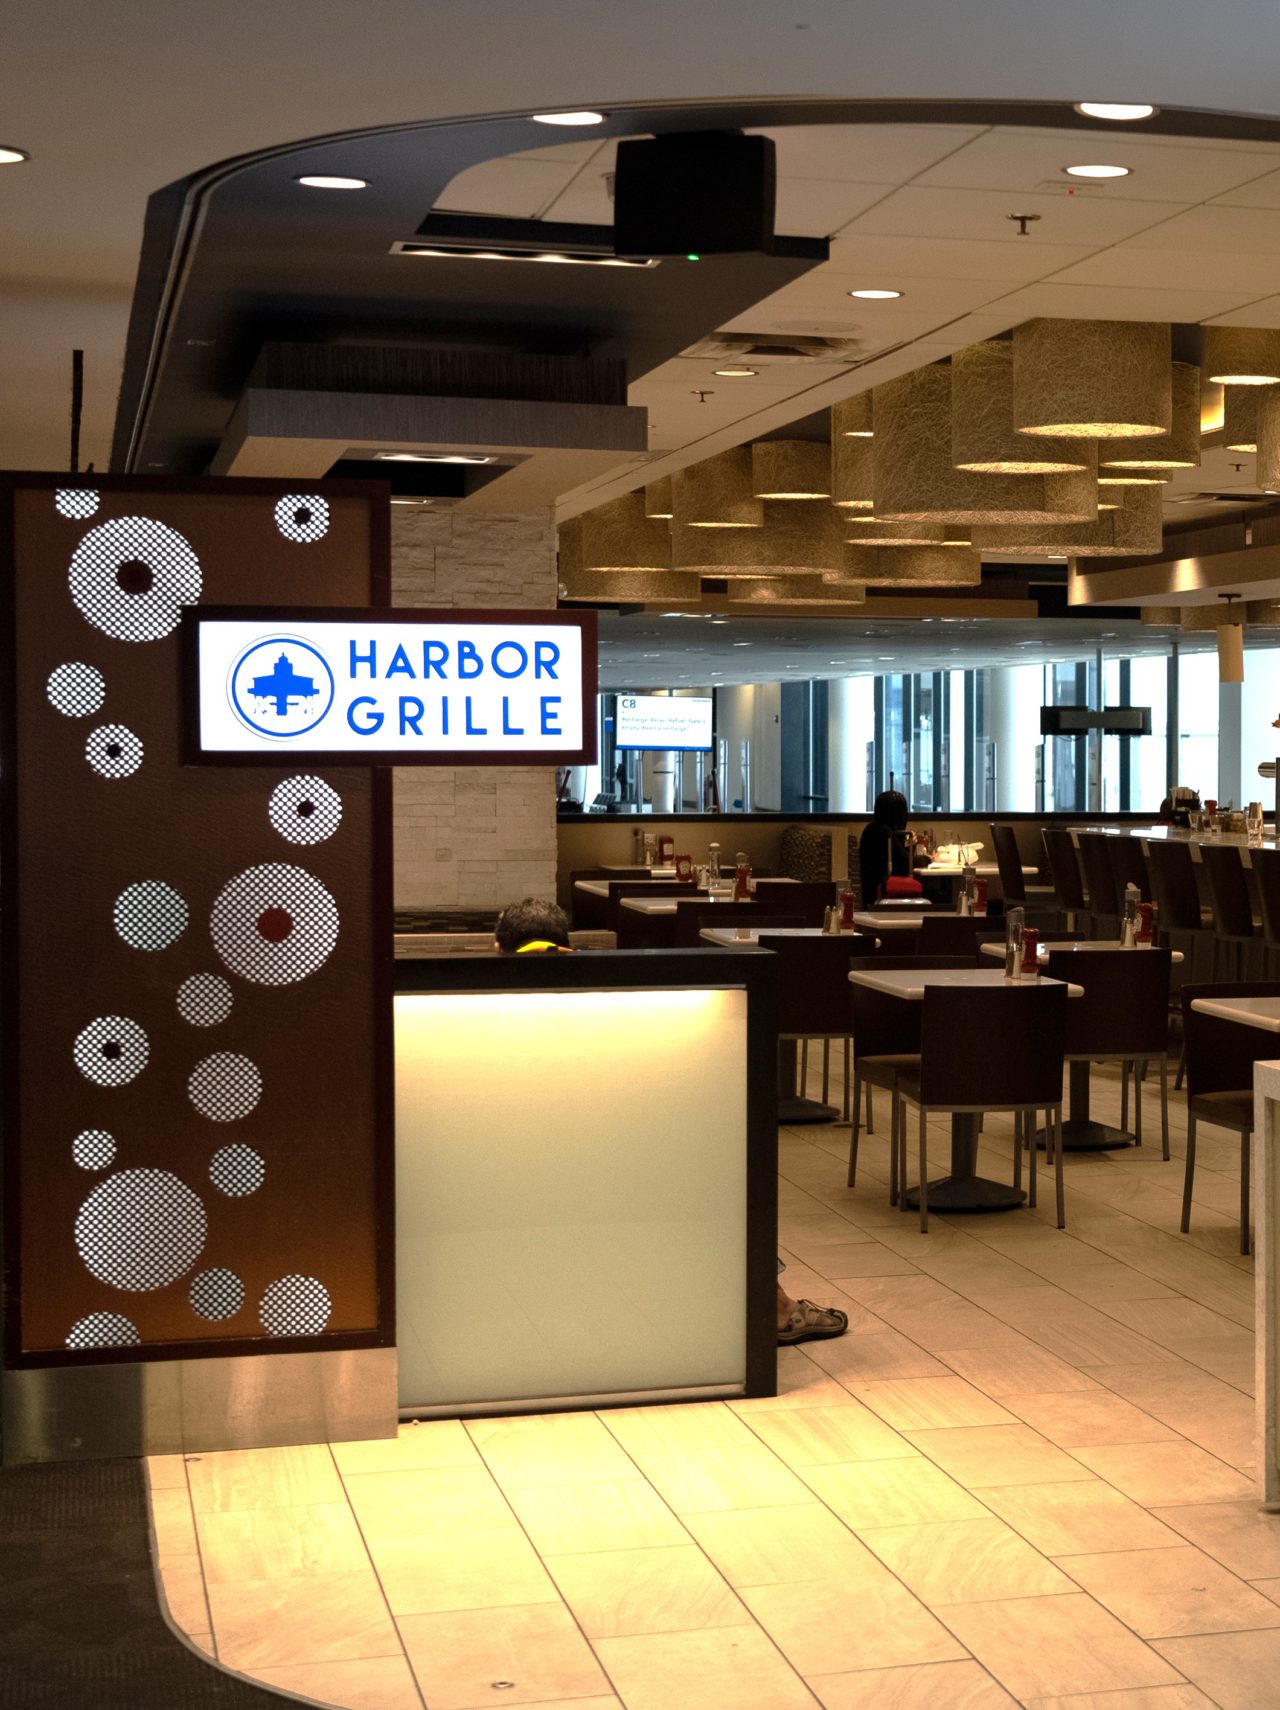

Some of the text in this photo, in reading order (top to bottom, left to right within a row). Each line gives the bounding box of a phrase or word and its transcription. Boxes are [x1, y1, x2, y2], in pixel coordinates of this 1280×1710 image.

[349, 639, 561, 680] HARBOR
[346, 695, 562, 736] GRILLE
[622, 698, 636, 709] C8
